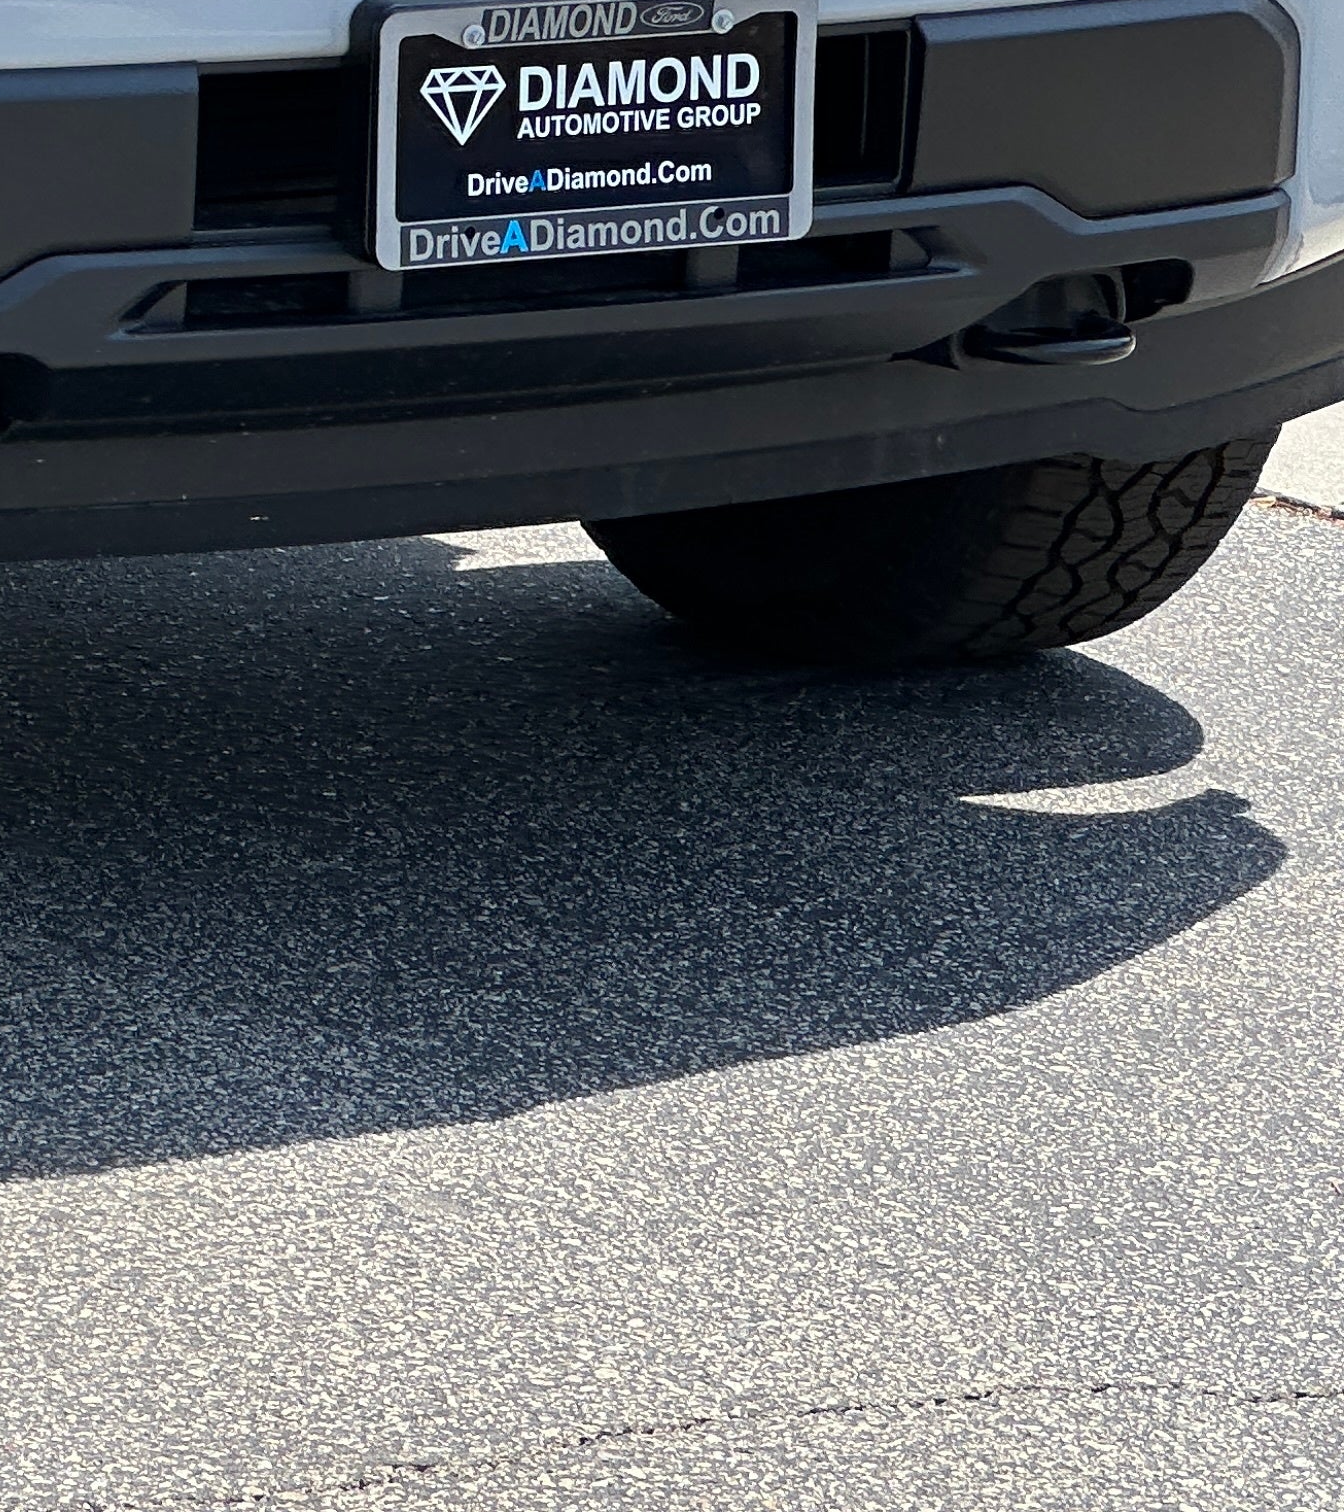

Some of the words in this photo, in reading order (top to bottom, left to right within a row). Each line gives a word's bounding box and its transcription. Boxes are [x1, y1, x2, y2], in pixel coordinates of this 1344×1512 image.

[487, 1, 638, 44] DIAMOND
[651, 5, 693, 24] Ford
[518, 53, 760, 112] DIAMOND
[517, 109, 670, 139] AUTOMOTIVE
[677, 103, 761, 129] GROUP
[467, 160, 712, 197] DriveADiamond.Com
[409, 206, 780, 262] DriveADiamond.Com
